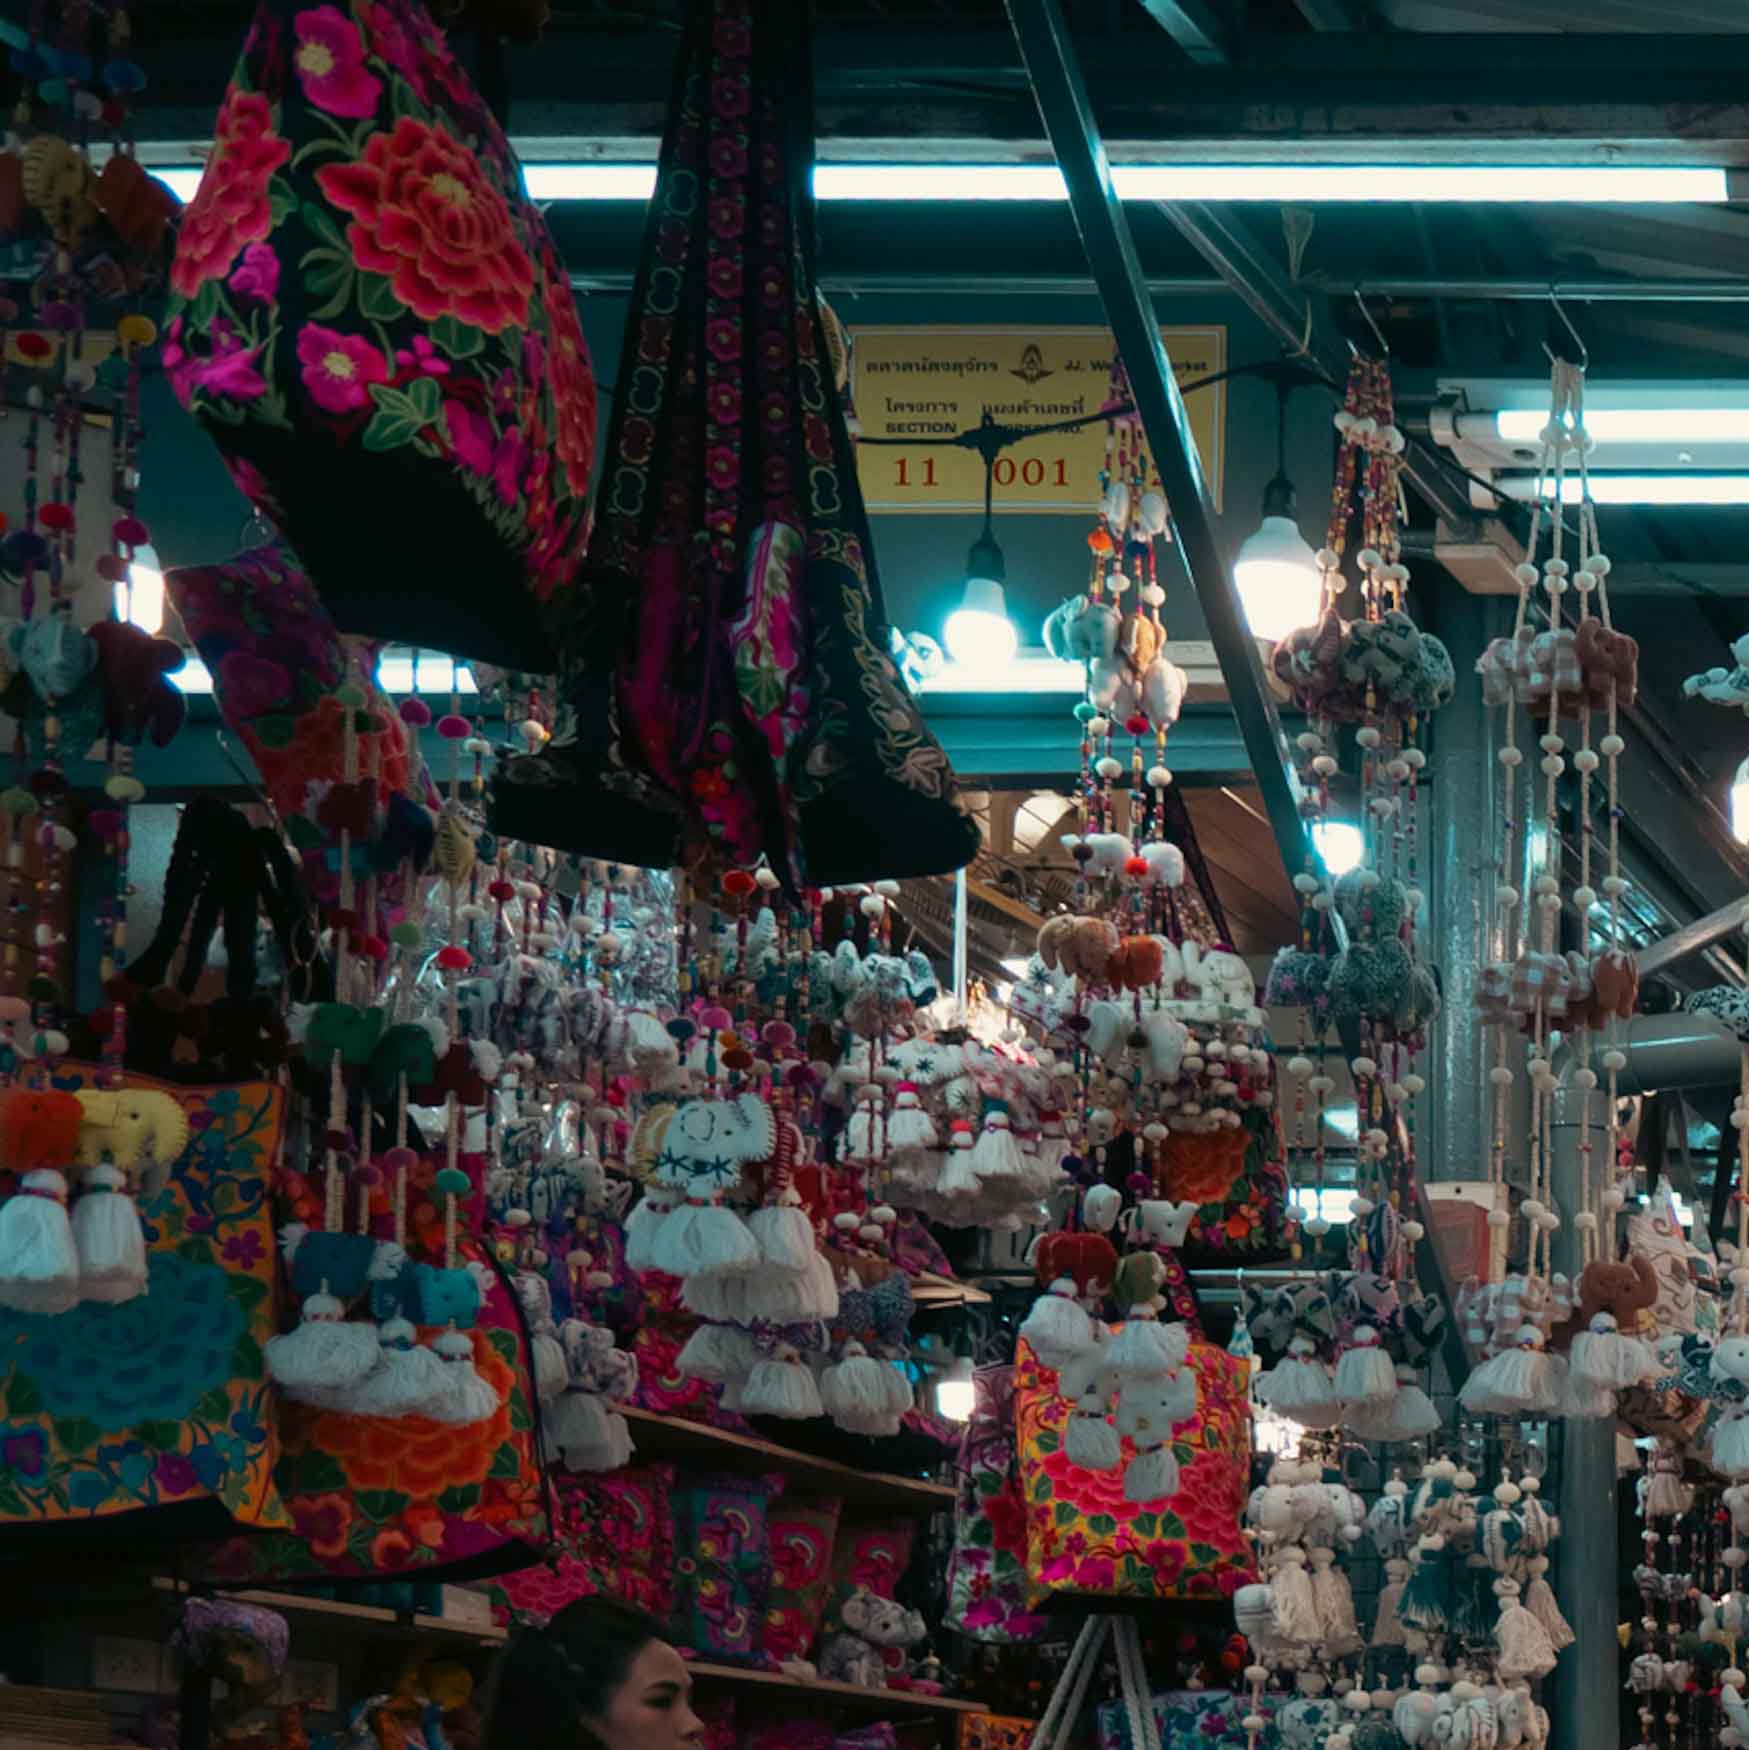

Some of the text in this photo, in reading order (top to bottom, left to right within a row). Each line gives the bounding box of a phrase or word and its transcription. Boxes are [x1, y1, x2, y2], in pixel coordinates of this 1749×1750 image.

[886, 397, 958, 413] โครงการ
[886, 422, 957, 433] SECTION
[895, 457, 938, 486] 11
[993, 457, 1069, 487] 001
